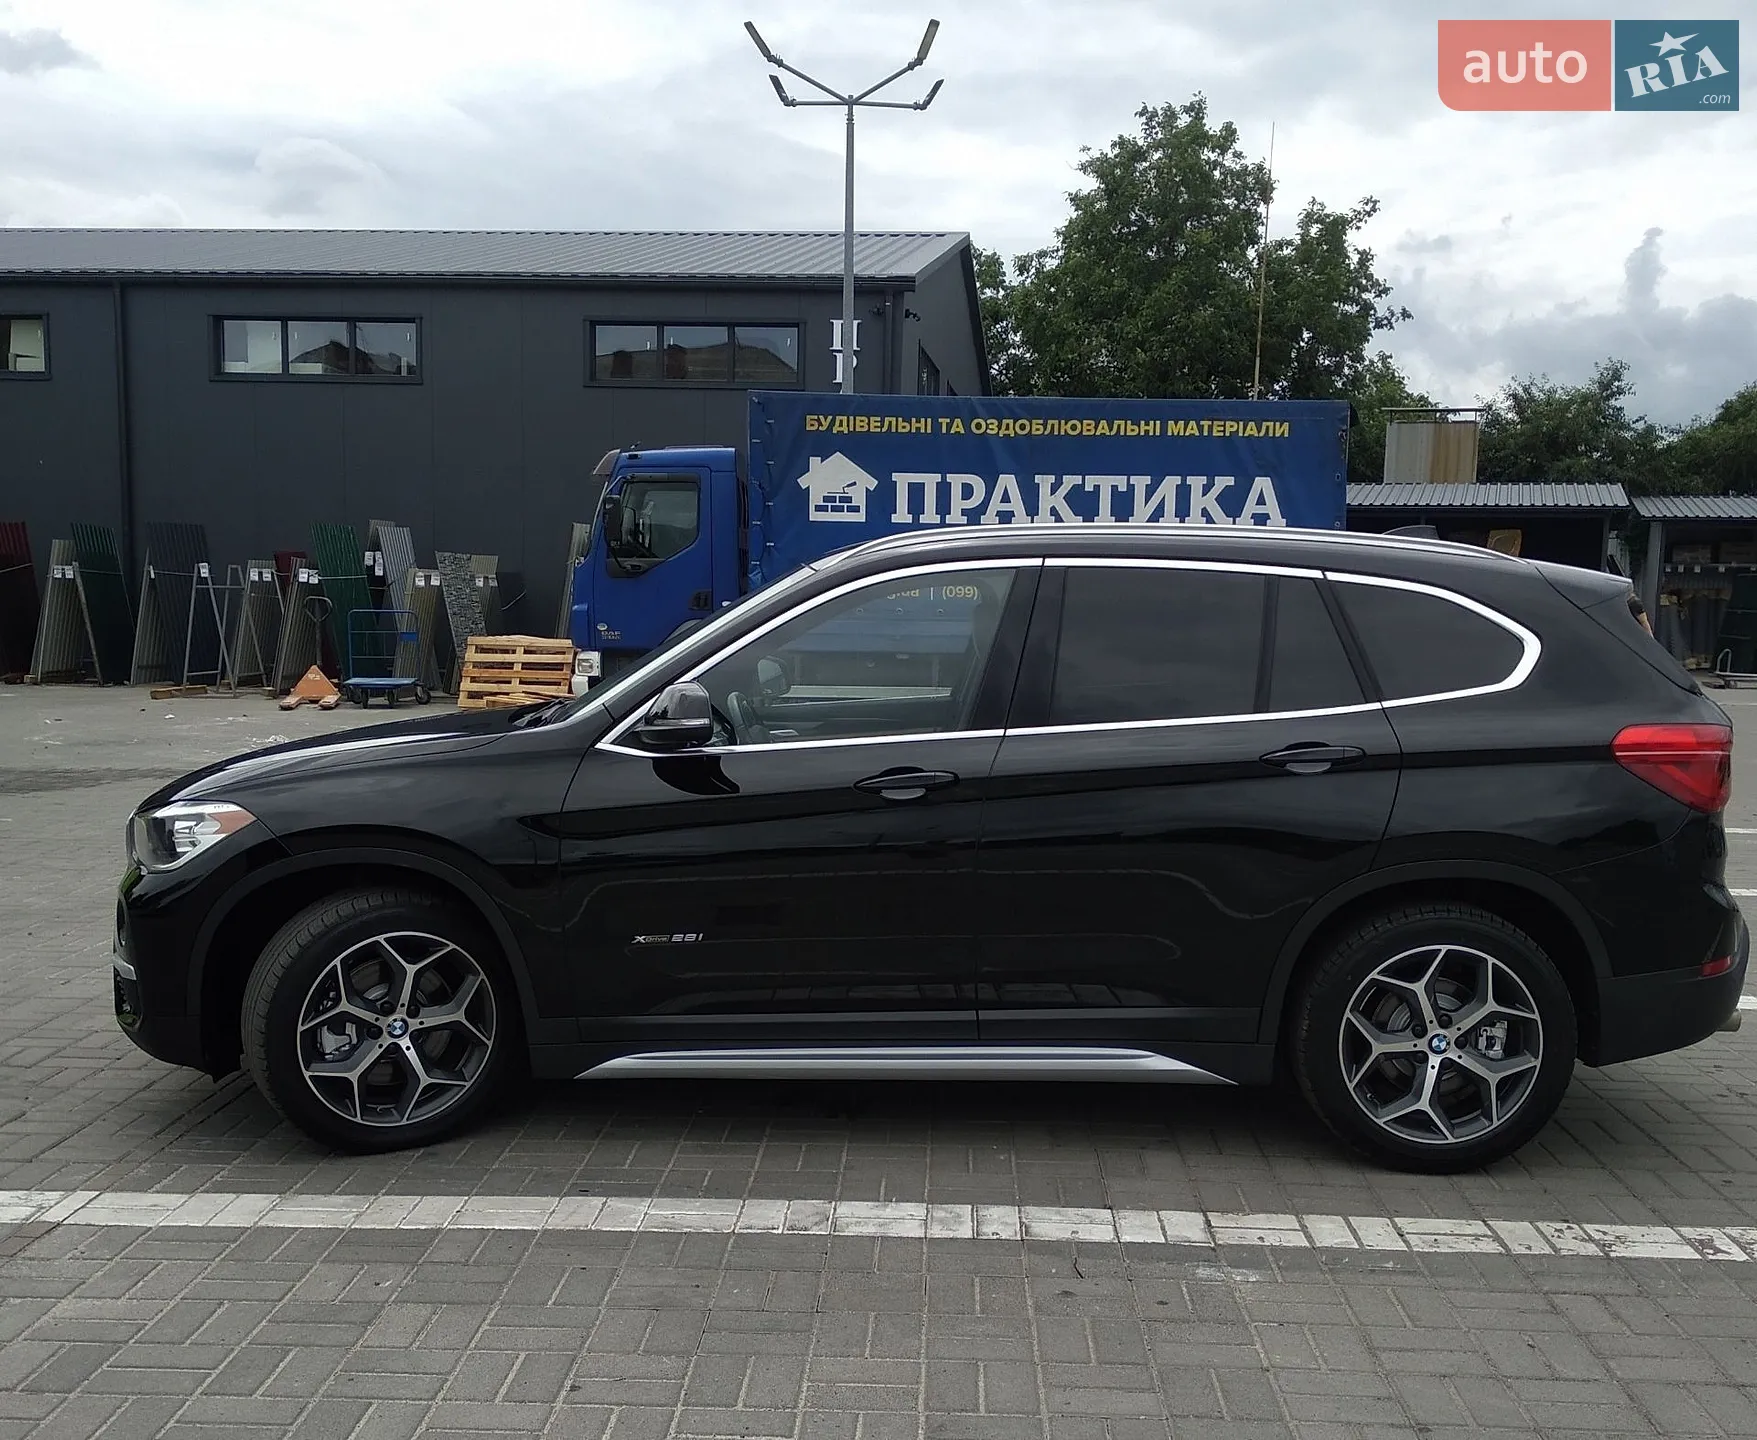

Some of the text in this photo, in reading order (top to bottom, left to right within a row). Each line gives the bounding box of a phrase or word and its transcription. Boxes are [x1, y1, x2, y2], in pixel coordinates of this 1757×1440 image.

[806, 415, 1289, 437] БУДІВЕЛЬНІ ТА ОЗДОБЛЮВАЛЬНІ МАТЕРІАЛИ
[891, 472, 1287, 527] ПРАКТИКА
[942, 586, 978, 600] (099)
